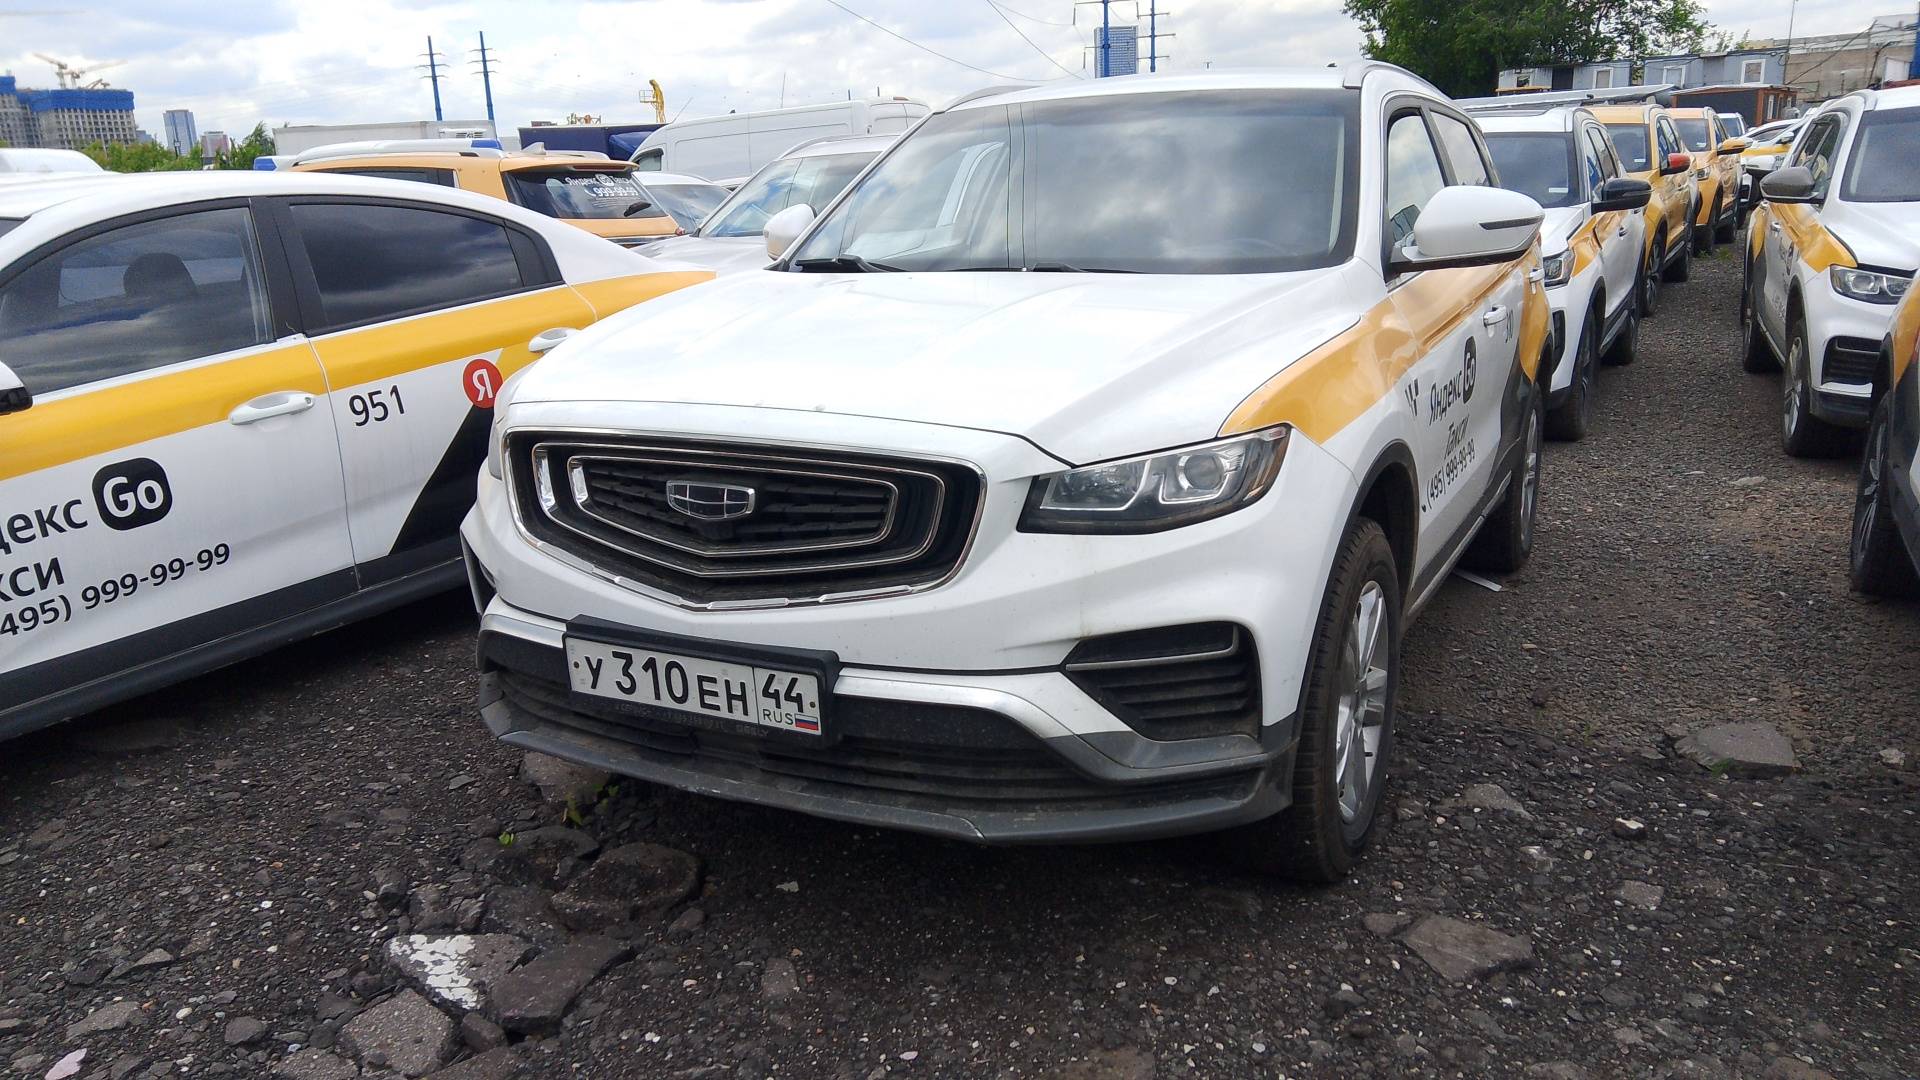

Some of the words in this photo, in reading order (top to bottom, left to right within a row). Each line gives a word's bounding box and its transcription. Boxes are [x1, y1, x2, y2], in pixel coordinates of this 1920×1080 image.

[348, 384, 406, 427] 951
[472, 368, 494, 402] Я
[1429, 370, 1463, 426] Яндекс
[1465, 351, 1476, 390] Go
[1444, 413, 1470, 460] Такси
[1426, 466, 1447, 510] (495)
[1446, 439, 1476, 486] 999-99-99
[102, 476, 164, 518] Go
[81, 542, 230, 610] 999-99-99
[762, 673, 804, 713] 44
[762, 708, 794, 726] RUS
